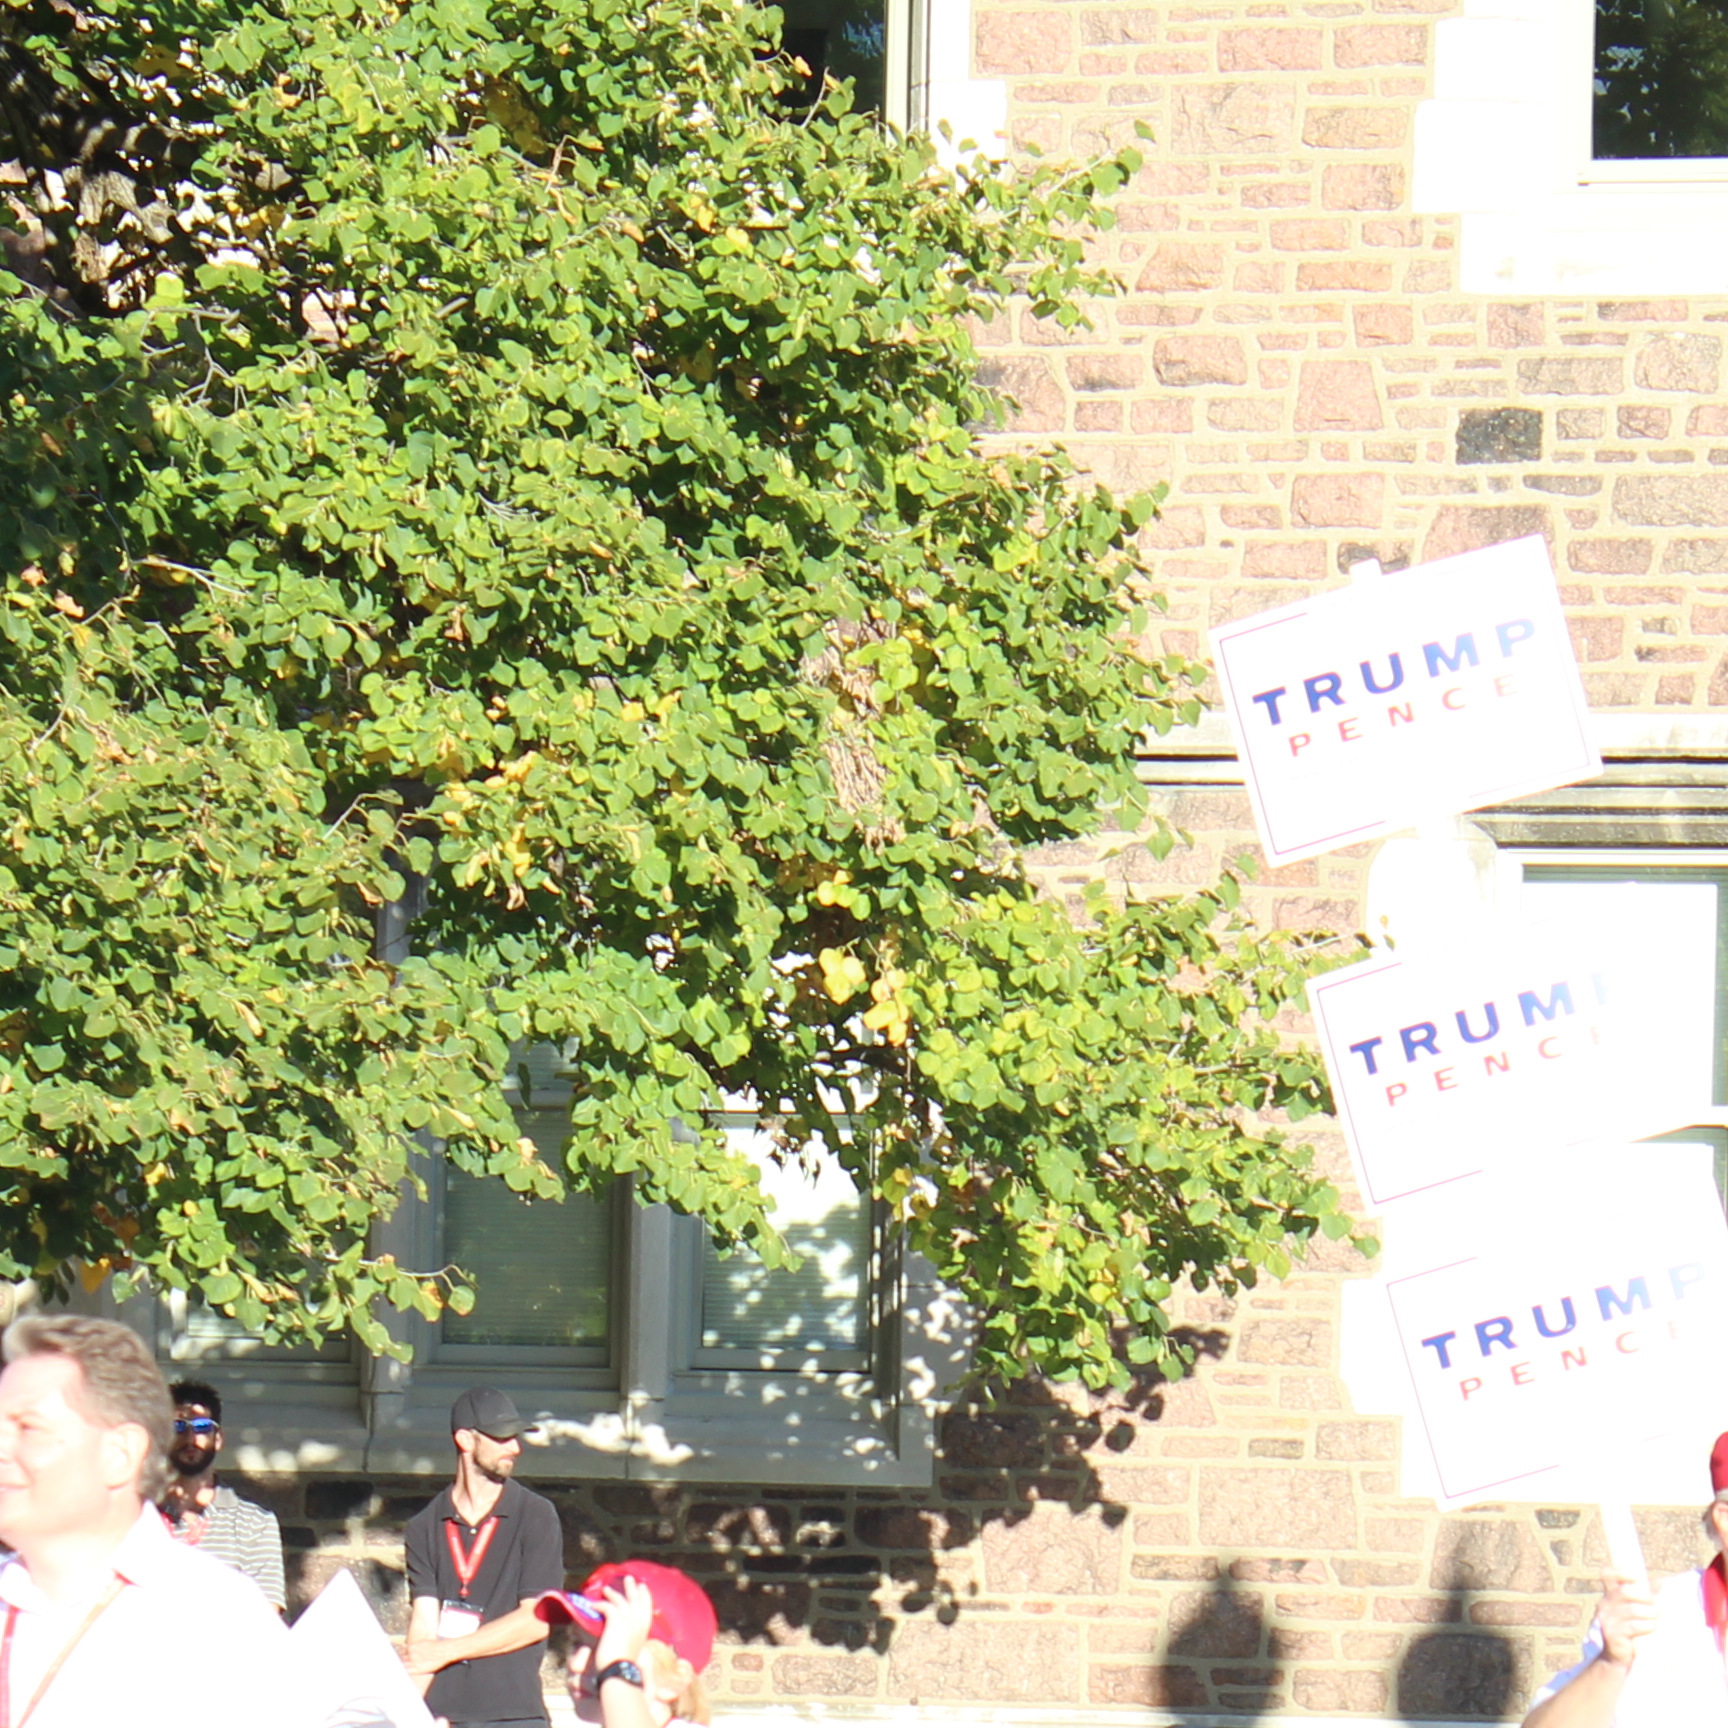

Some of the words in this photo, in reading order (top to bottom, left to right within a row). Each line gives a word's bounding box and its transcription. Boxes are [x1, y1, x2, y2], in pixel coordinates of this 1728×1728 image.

[1251, 618, 1535, 726] TRUMP
[1288, 674, 1519, 758] PENCE
[1421, 1262, 1706, 1370] TRUMP
